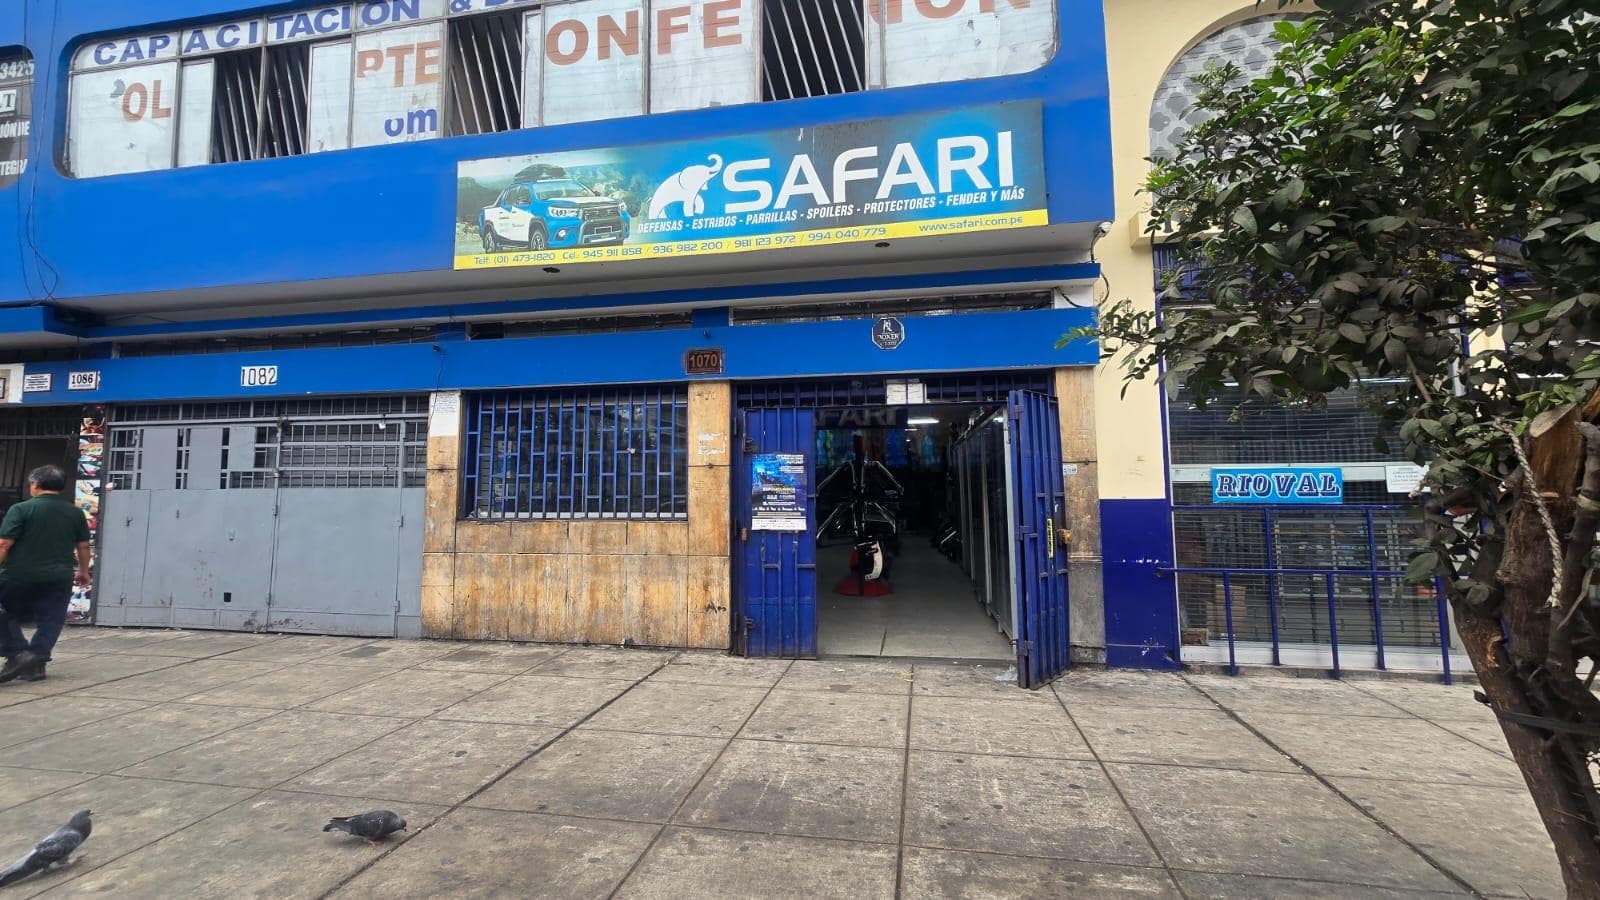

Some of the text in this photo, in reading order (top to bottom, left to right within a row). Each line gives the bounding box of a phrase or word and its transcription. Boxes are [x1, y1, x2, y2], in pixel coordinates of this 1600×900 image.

[723, 130, 1015, 214] SAFARI
[637, 220, 683, 234] DEFENSAS
[692, 216, 737, 230] ESTRIBOS
[746, 210, 797, 225] PARRILLAS
[806, 204, 854, 220] SPOILERS
[863, 196, 936, 214] PROTECTORES
[946, 191, 987, 207] FENDER
[991, 190, 998, 202] Y
[1000, 186, 1025, 201] MÁS
[494, 255, 509, 265] (01)
[512, 252, 556, 262] 473-1820
[583, 249, 603, 259] 945
[606, 248, 618, 257] 911
[622, 247, 642, 256] 858
[653, 245, 673, 254] 936
[676, 243, 698, 252] 982
[701, 241, 723, 250] 200
[735, 239, 752, 248] 981
[756, 237, 771, 246] 123
[775, 235, 796, 245] 972
[808, 232, 831, 242] 994
[835, 229, 860, 239] 040
[863, 227, 887, 236] 779
[918, 215, 1024, 233] www.safari.com.pe
[689, 353, 718, 368] 1070
[71, 373, 94, 385] 1086
[241, 365, 278, 386] 1082
[815, 408, 897, 427] FARI
[1216, 472, 1341, 498] RIOVAL
